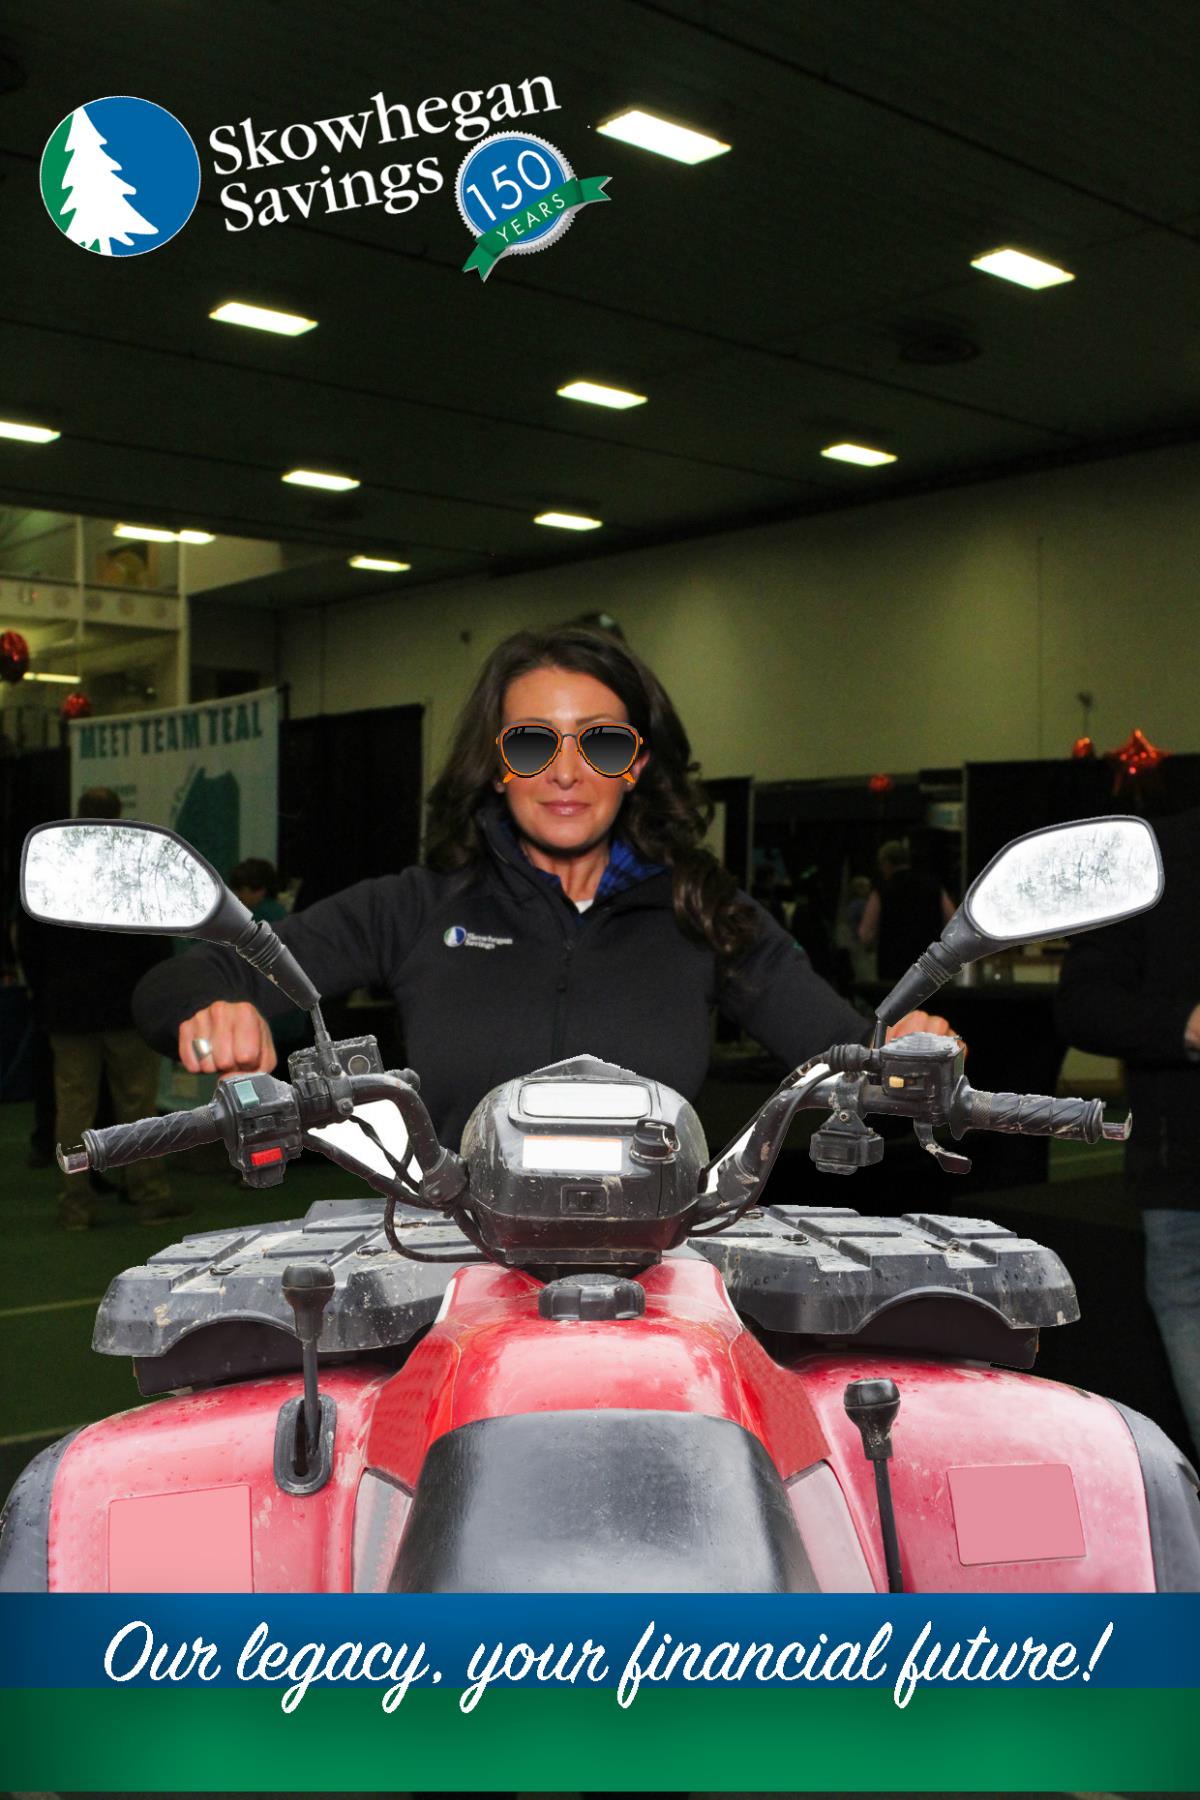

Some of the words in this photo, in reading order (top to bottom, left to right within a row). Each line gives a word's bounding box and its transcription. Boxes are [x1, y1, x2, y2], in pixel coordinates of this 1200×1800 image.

[79, 721, 132, 760] MEET
[140, 711, 202, 754] TEAM
[206, 700, 263, 747] TEAL
